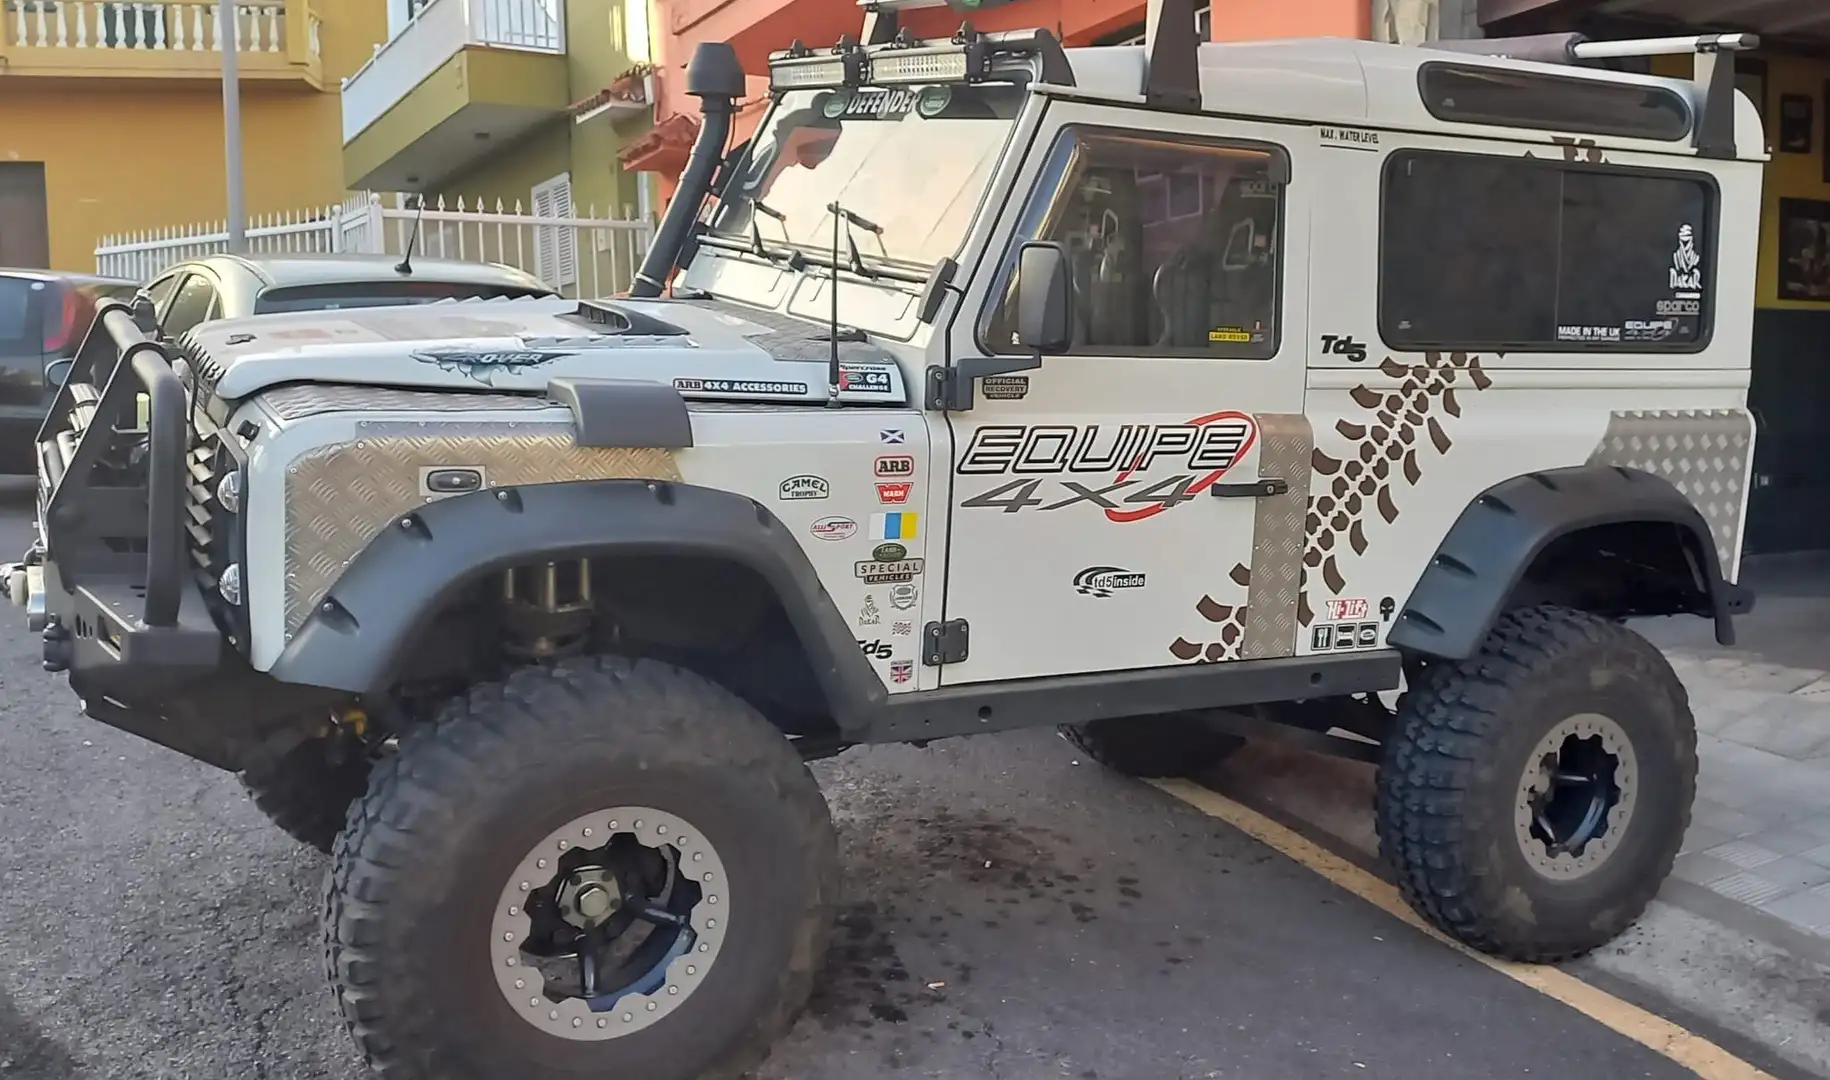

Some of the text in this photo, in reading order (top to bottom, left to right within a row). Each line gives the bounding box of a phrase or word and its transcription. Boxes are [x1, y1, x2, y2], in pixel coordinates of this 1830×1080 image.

[845, 89, 921, 119] DEFENDER
[1669, 267, 1702, 290] DAKAR
[1656, 300, 1700, 312] sparco
[1558, 326, 1581, 336] MADE
[1582, 327, 1592, 336] IN
[1593, 327, 1608, 337] THE
[1609, 328, 1621, 337] UK
[1321, 335, 1367, 362] Td5
[866, 373, 888, 384] G4
[985, 377, 1027, 385] OFFICIAL
[676, 381, 701, 389] ARB
[732, 382, 806, 394] ACCESSORIES
[848, 383, 889, 391] CHALLENGE
[985, 385, 1026, 393] RECOVERY
[956, 424, 1248, 475] EQUIPE
[878, 460, 911, 472] ARB
[782, 478, 827, 492] CAMEL
[860, 562, 920, 574] SPECIAL
[867, 573, 912, 583] VEHICLES
